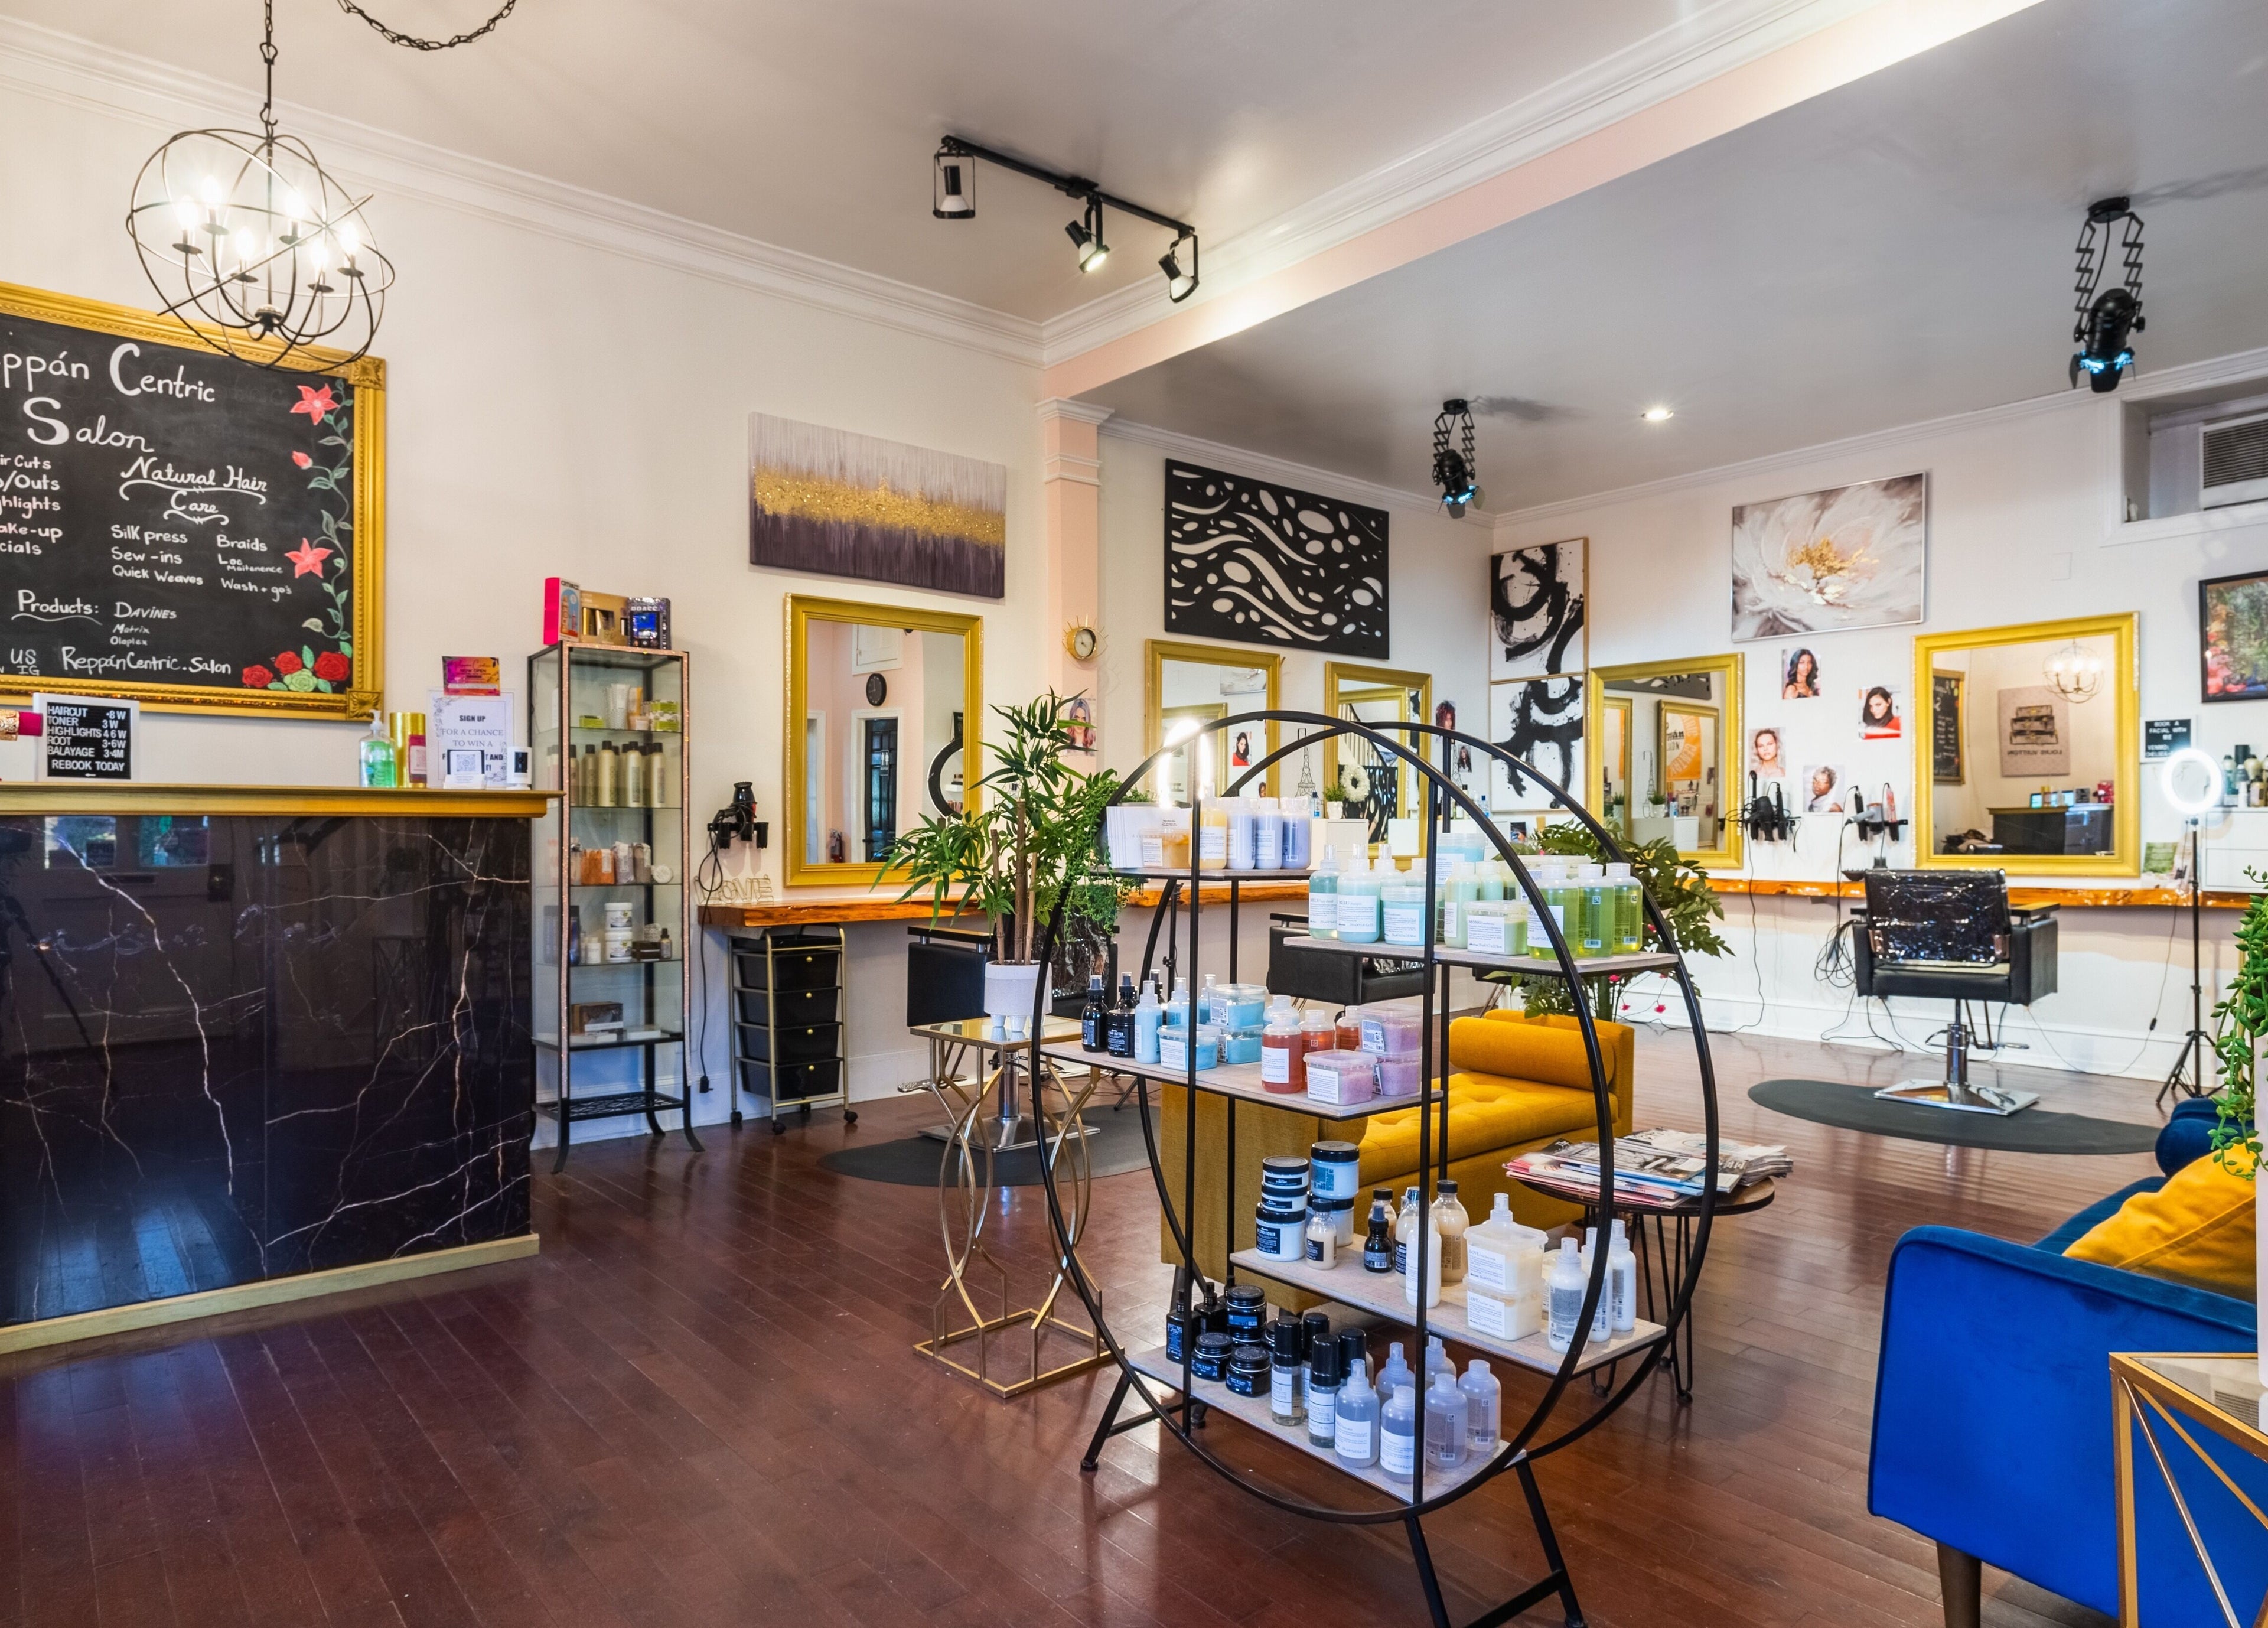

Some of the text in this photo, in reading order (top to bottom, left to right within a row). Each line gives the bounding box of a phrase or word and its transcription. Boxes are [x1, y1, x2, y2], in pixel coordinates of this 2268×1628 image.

[0, 343, 216, 402] ppán Centric
[23, 396, 155, 452] Salon
[0, 454, 51, 470] ir Cuts
[120, 456, 267, 491] Natural Hair
[0, 495, 61, 519] hlights
[170, 490, 218, 513] Care
[0, 522, 63, 543] ake-up
[144, 531, 188, 545] press
[0, 541, 42, 555] cials
[217, 534, 268, 551] Braids
[112, 565, 203, 585] Quick Weaves
[221, 578, 258, 592] Wash
[18, 590, 99, 614] Products:
[112, 623, 150, 634] Matrix
[110, 636, 148, 647] Olaplex
[11, 649, 37, 665] US
[48, 706, 88, 717] HAIRCUT
[48, 716, 79, 727] TONER
[48, 727, 102, 738] HIGHLIGHTS
[48, 737, 71, 746] ROOT
[48, 746, 94, 757] BALAYAGE
[52, 759, 125, 771] REBOOK TODAY
